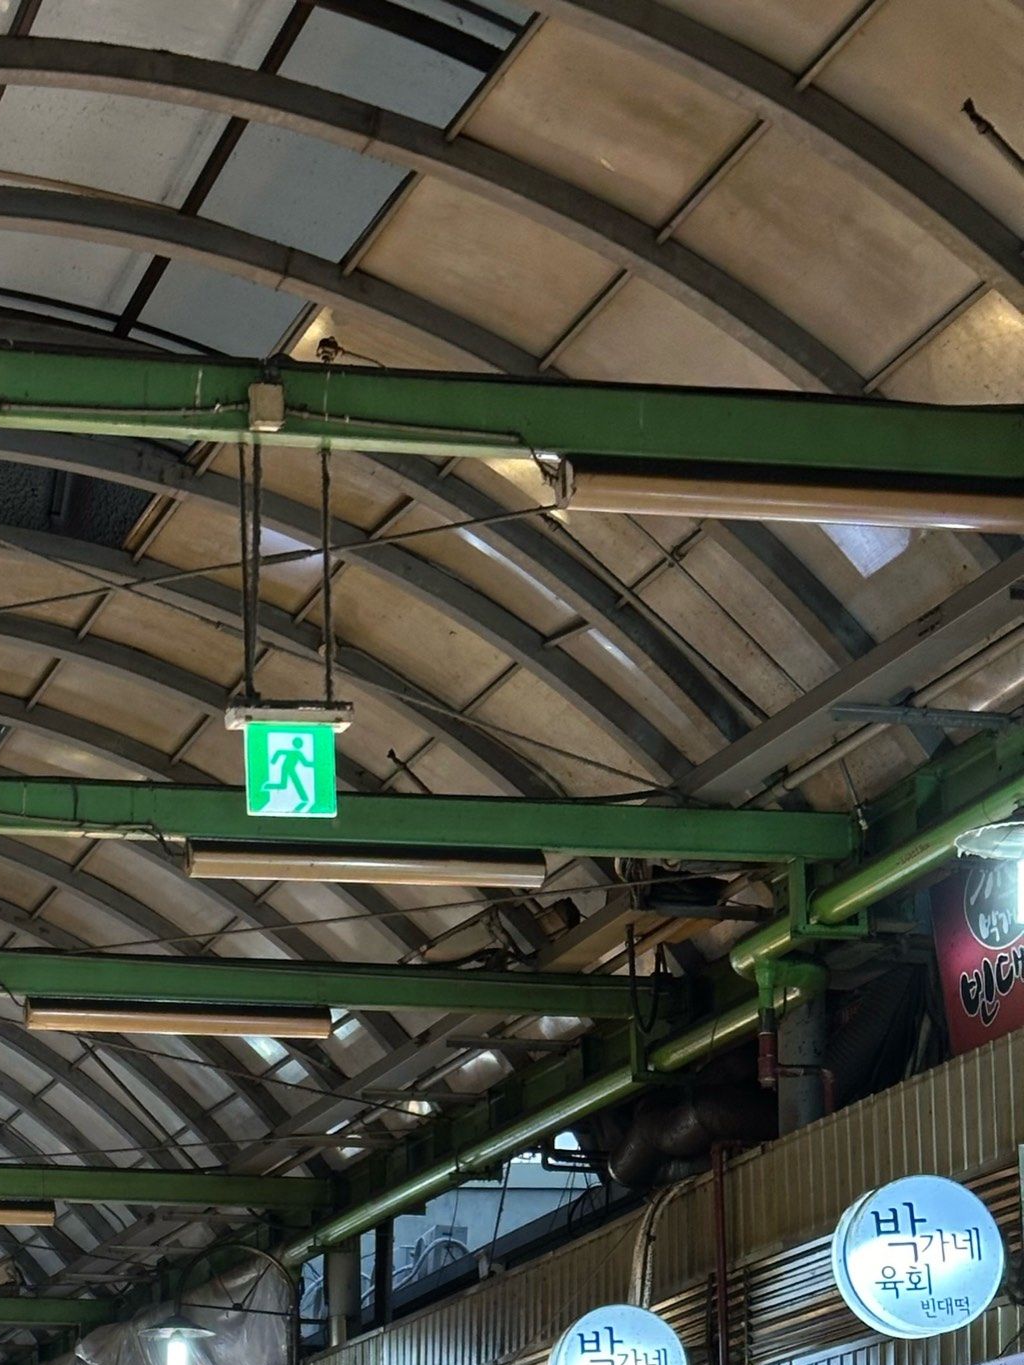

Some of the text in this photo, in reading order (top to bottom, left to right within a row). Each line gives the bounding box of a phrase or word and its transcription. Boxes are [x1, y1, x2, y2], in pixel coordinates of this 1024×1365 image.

[871, 1202, 981, 1264] 박가네
[875, 1264, 932, 1299] 육회
[921, 1296, 970, 1318] 빈대떡
